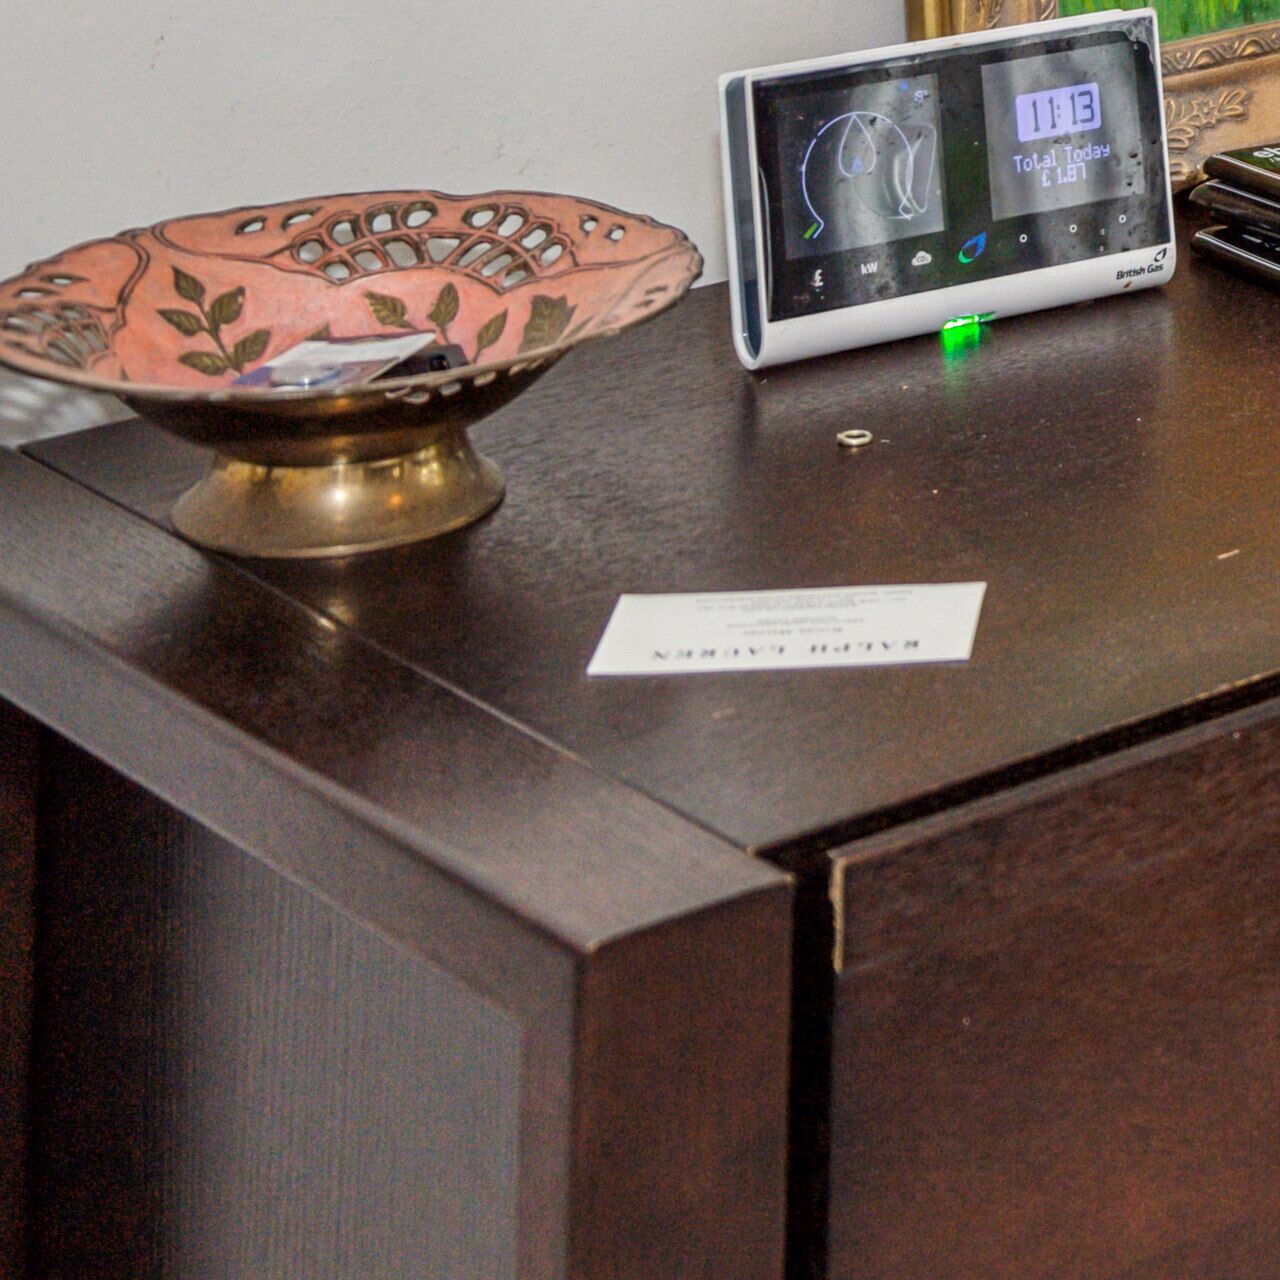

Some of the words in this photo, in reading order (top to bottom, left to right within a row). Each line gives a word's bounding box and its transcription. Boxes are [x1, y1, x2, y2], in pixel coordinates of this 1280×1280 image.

[1031, 89, 1095, 133] 11:13
[1013, 149, 1057, 174] Total
[1063, 142, 1111, 164] Today
[860, 261, 879, 275] kW
[1116, 265, 1145, 280] British
[1147, 263, 1164, 273] Gas
